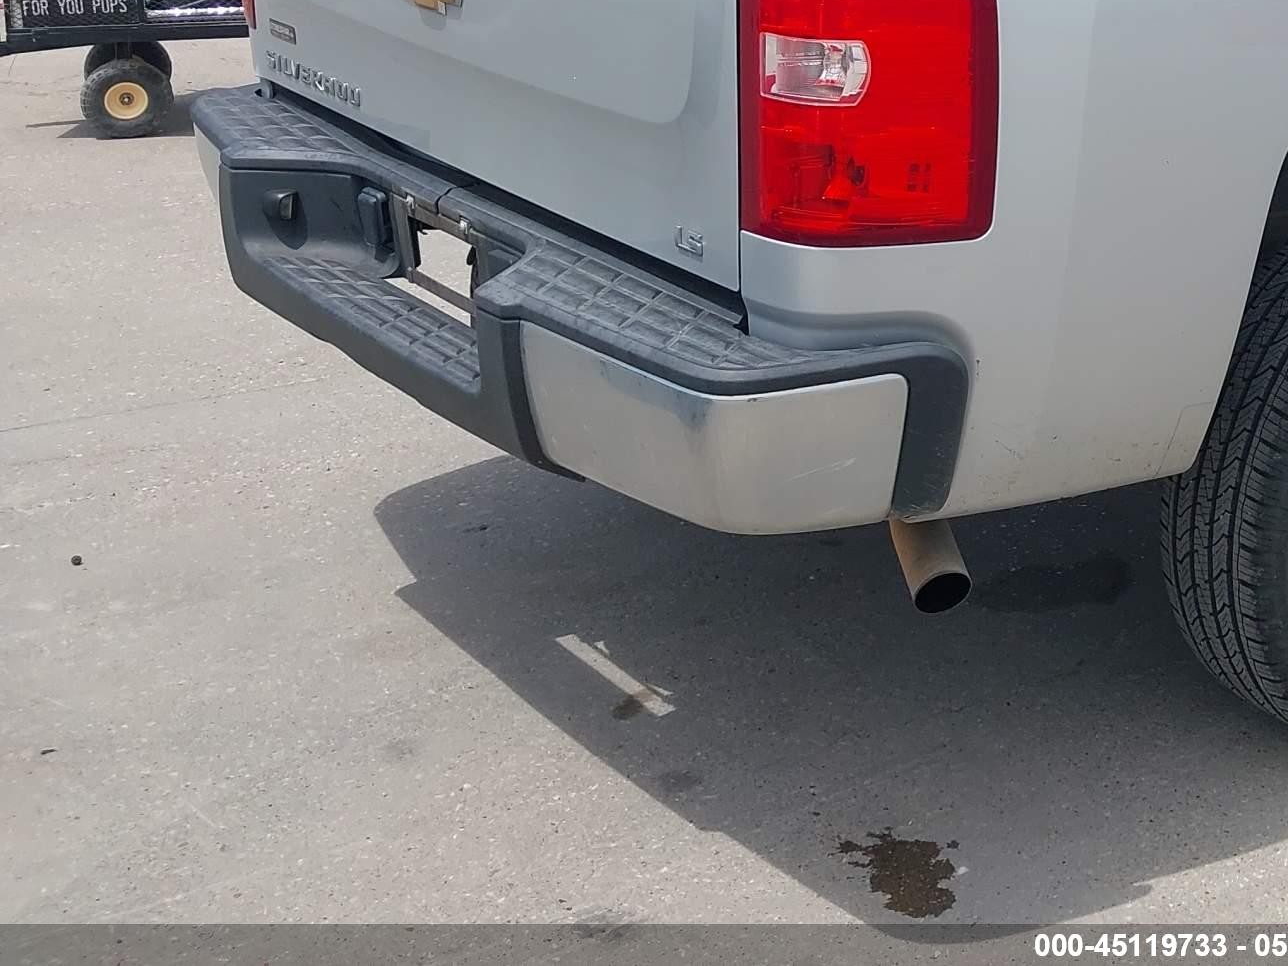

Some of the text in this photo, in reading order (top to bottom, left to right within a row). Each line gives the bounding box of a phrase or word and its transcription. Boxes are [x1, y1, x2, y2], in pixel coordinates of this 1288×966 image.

[22, 0, 49, 16] FOR
[265, 50, 361, 107] SILVERADO
[675, 225, 704, 257] LS
